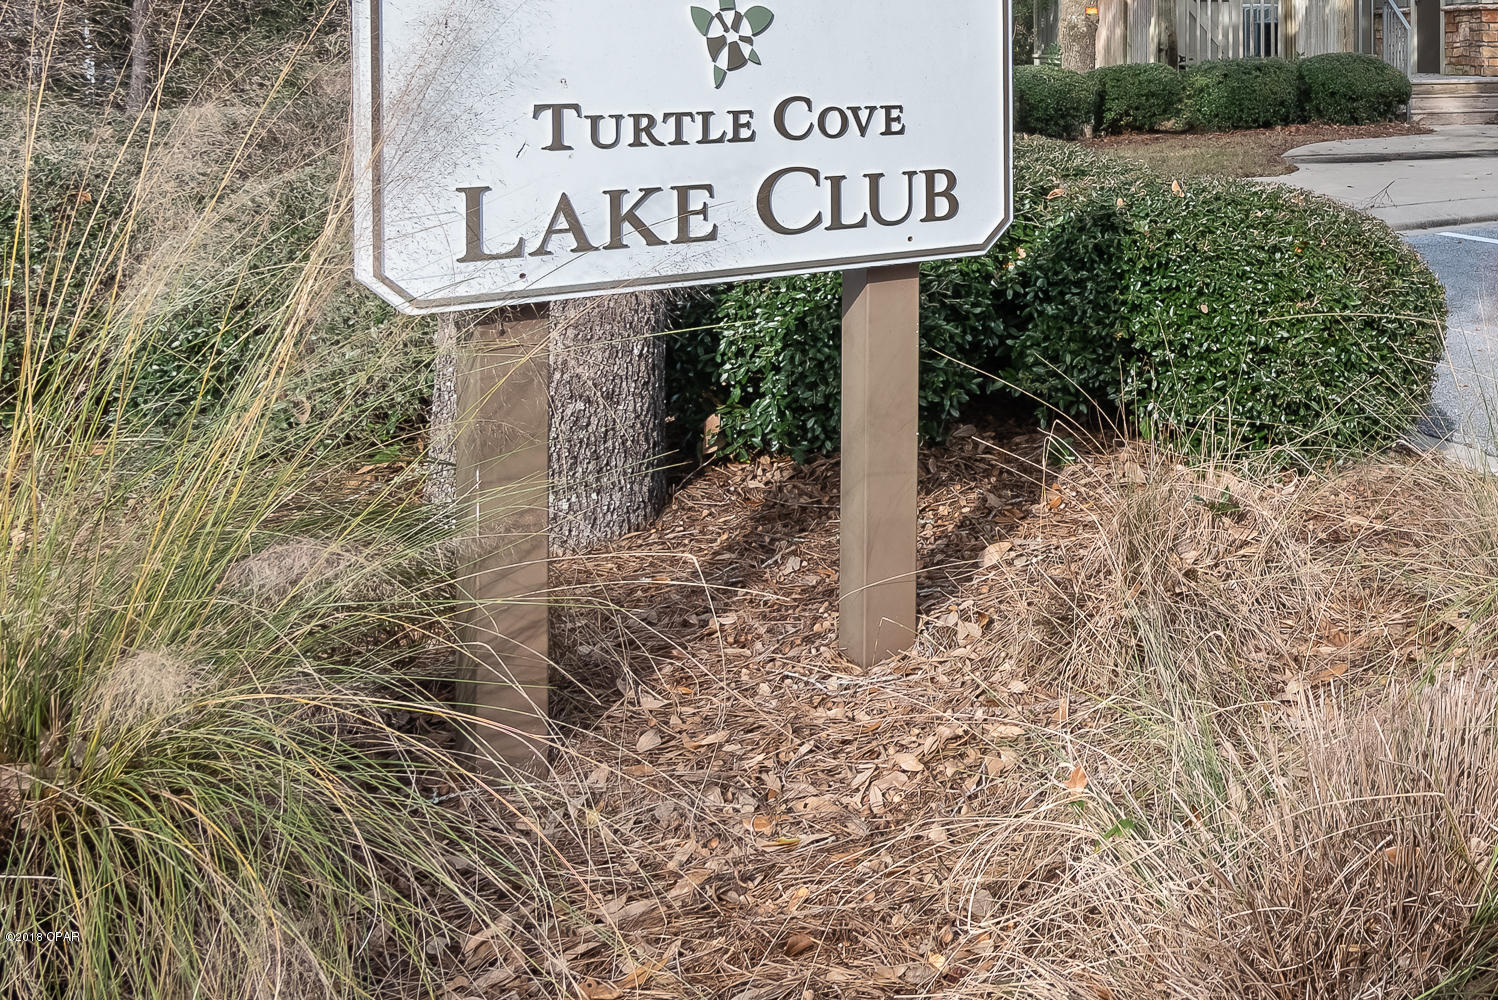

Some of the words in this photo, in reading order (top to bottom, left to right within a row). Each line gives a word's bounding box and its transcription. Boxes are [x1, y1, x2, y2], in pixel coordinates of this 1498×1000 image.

[532, 102, 757, 152] TURTLE
[773, 95, 906, 141] COVE
[455, 183, 719, 264] LAKE
[756, 166, 960, 236] CLUB
